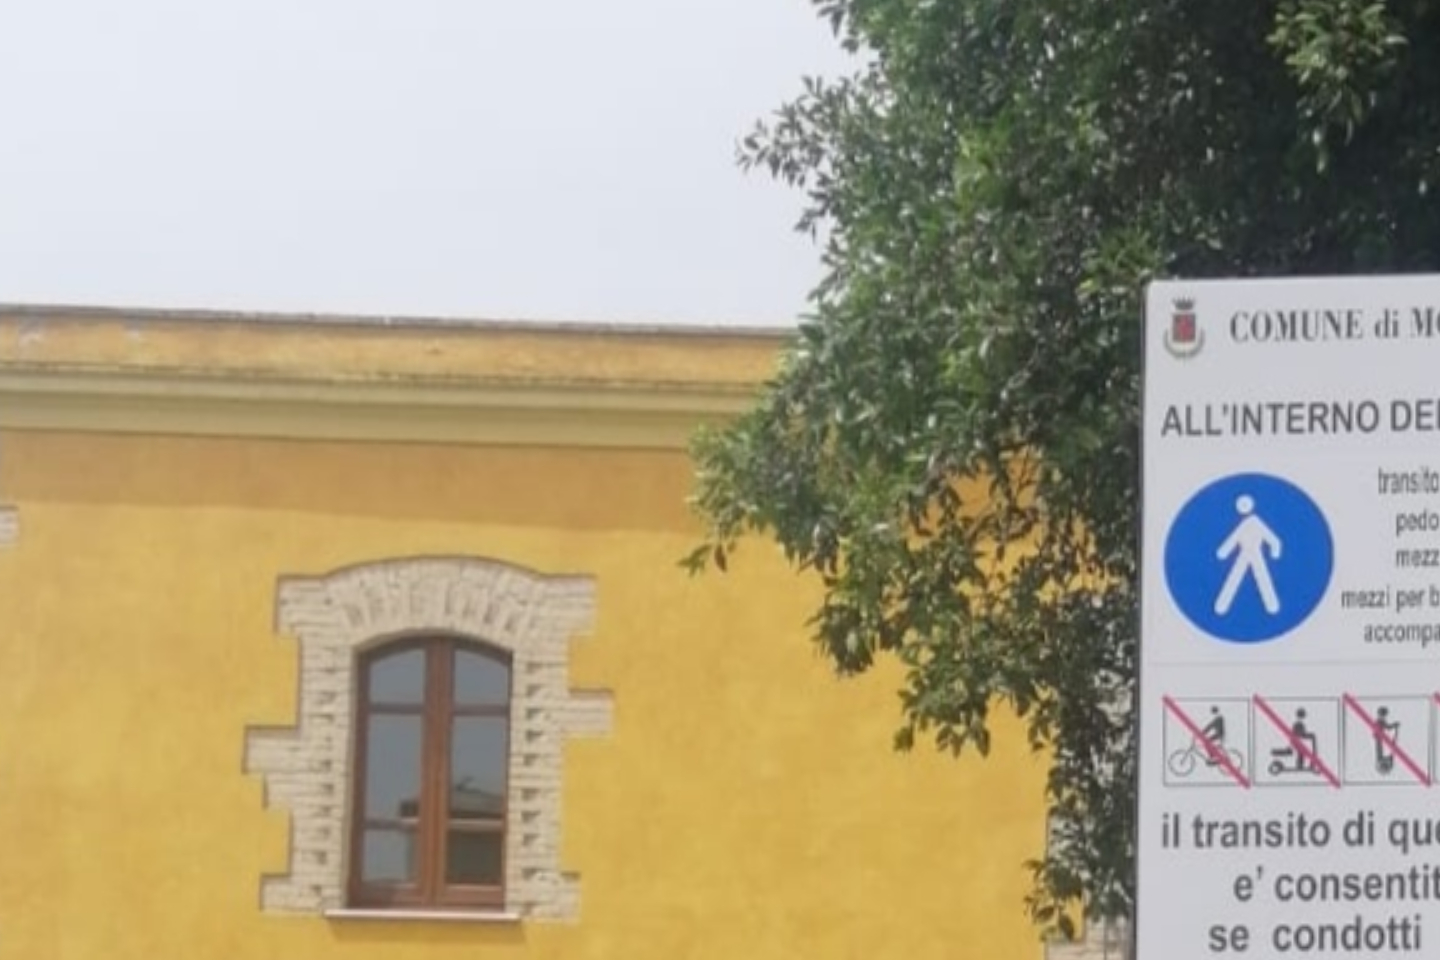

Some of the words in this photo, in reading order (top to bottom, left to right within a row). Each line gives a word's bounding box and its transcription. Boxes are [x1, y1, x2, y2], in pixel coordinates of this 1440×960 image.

[1230, 309, 1363, 342] COMUNE
[1374, 308, 1399, 338] di
[1161, 400, 1380, 437] ALL'INTERNO
[1378, 467, 1439, 494] transito
[1341, 587, 1390, 608] mezzi
[1396, 590, 1425, 613] per
[1162, 812, 1180, 848] il
[1192, 812, 1331, 849] transito
[1343, 811, 1374, 847] di
[1233, 865, 1264, 902] e'
[1209, 925, 1250, 953] se
[1272, 913, 1421, 952] condotti
